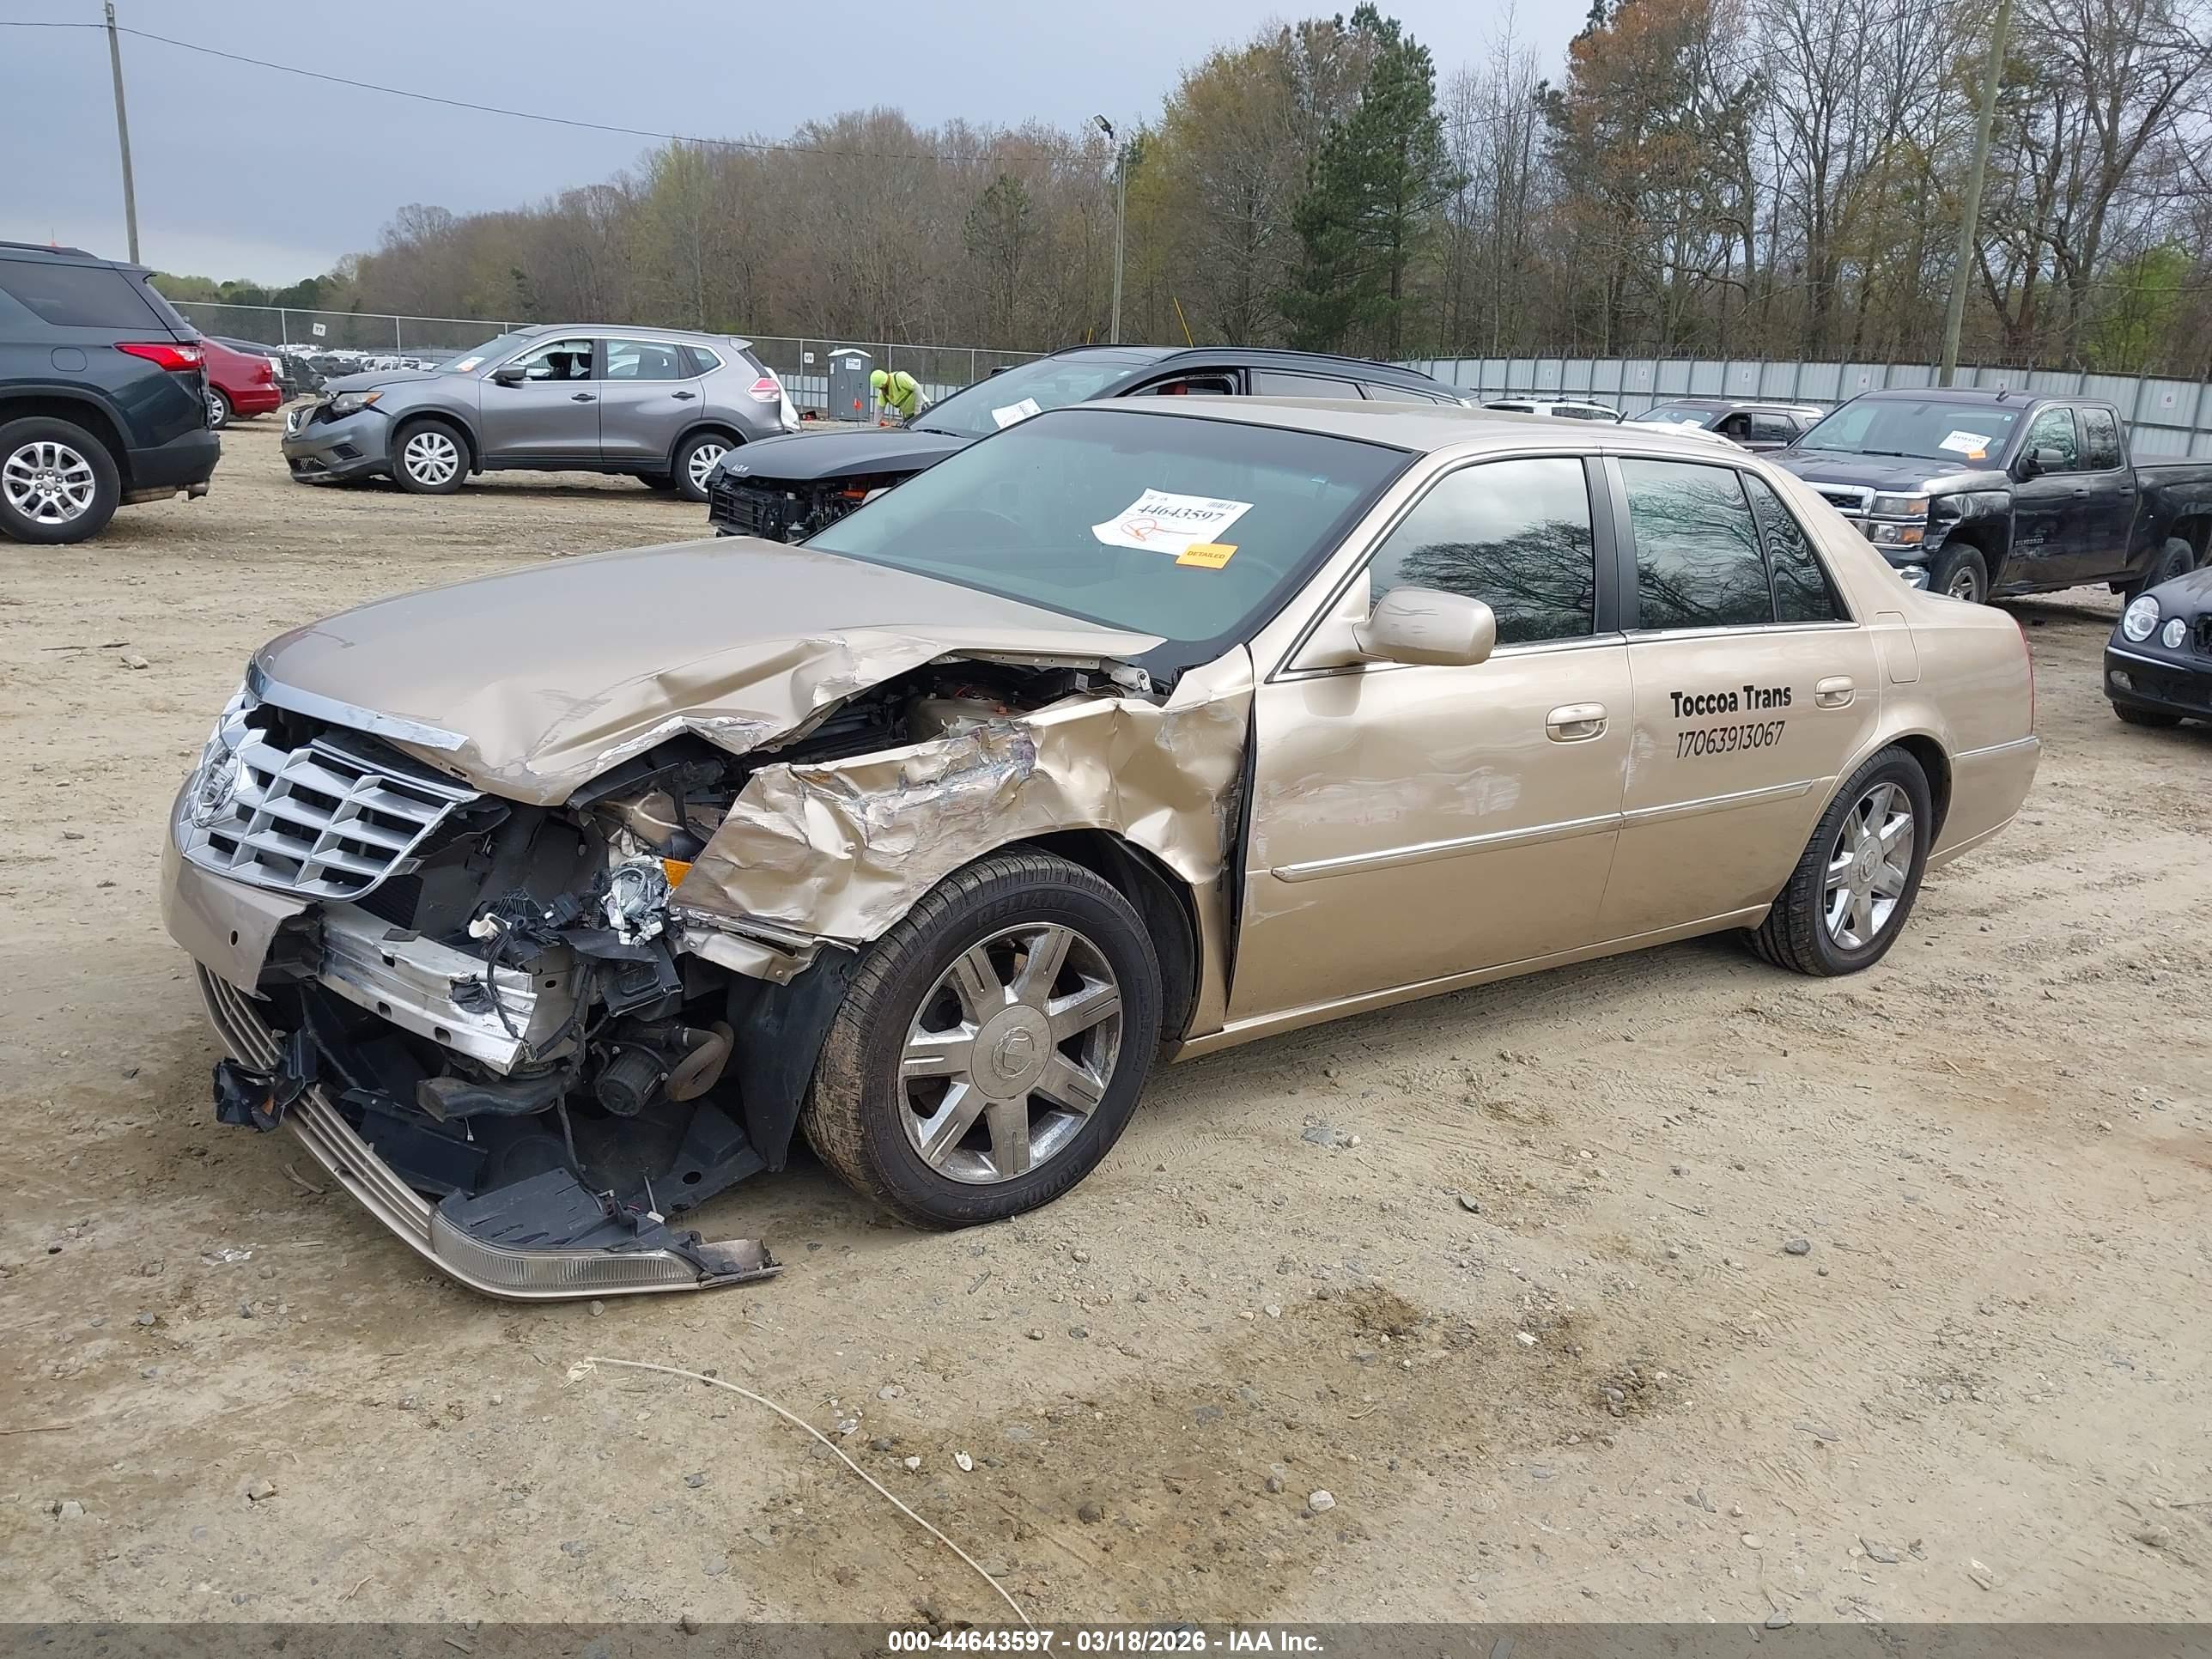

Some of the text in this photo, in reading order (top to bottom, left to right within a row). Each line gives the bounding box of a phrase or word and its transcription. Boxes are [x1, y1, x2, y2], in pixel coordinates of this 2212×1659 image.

[1138, 504, 1227, 523] 44643597
[1186, 550, 1226, 560] DETAILED
[1670, 685, 1792, 718] Toccoa Trans
[1676, 720, 1786, 759] 17063913067
